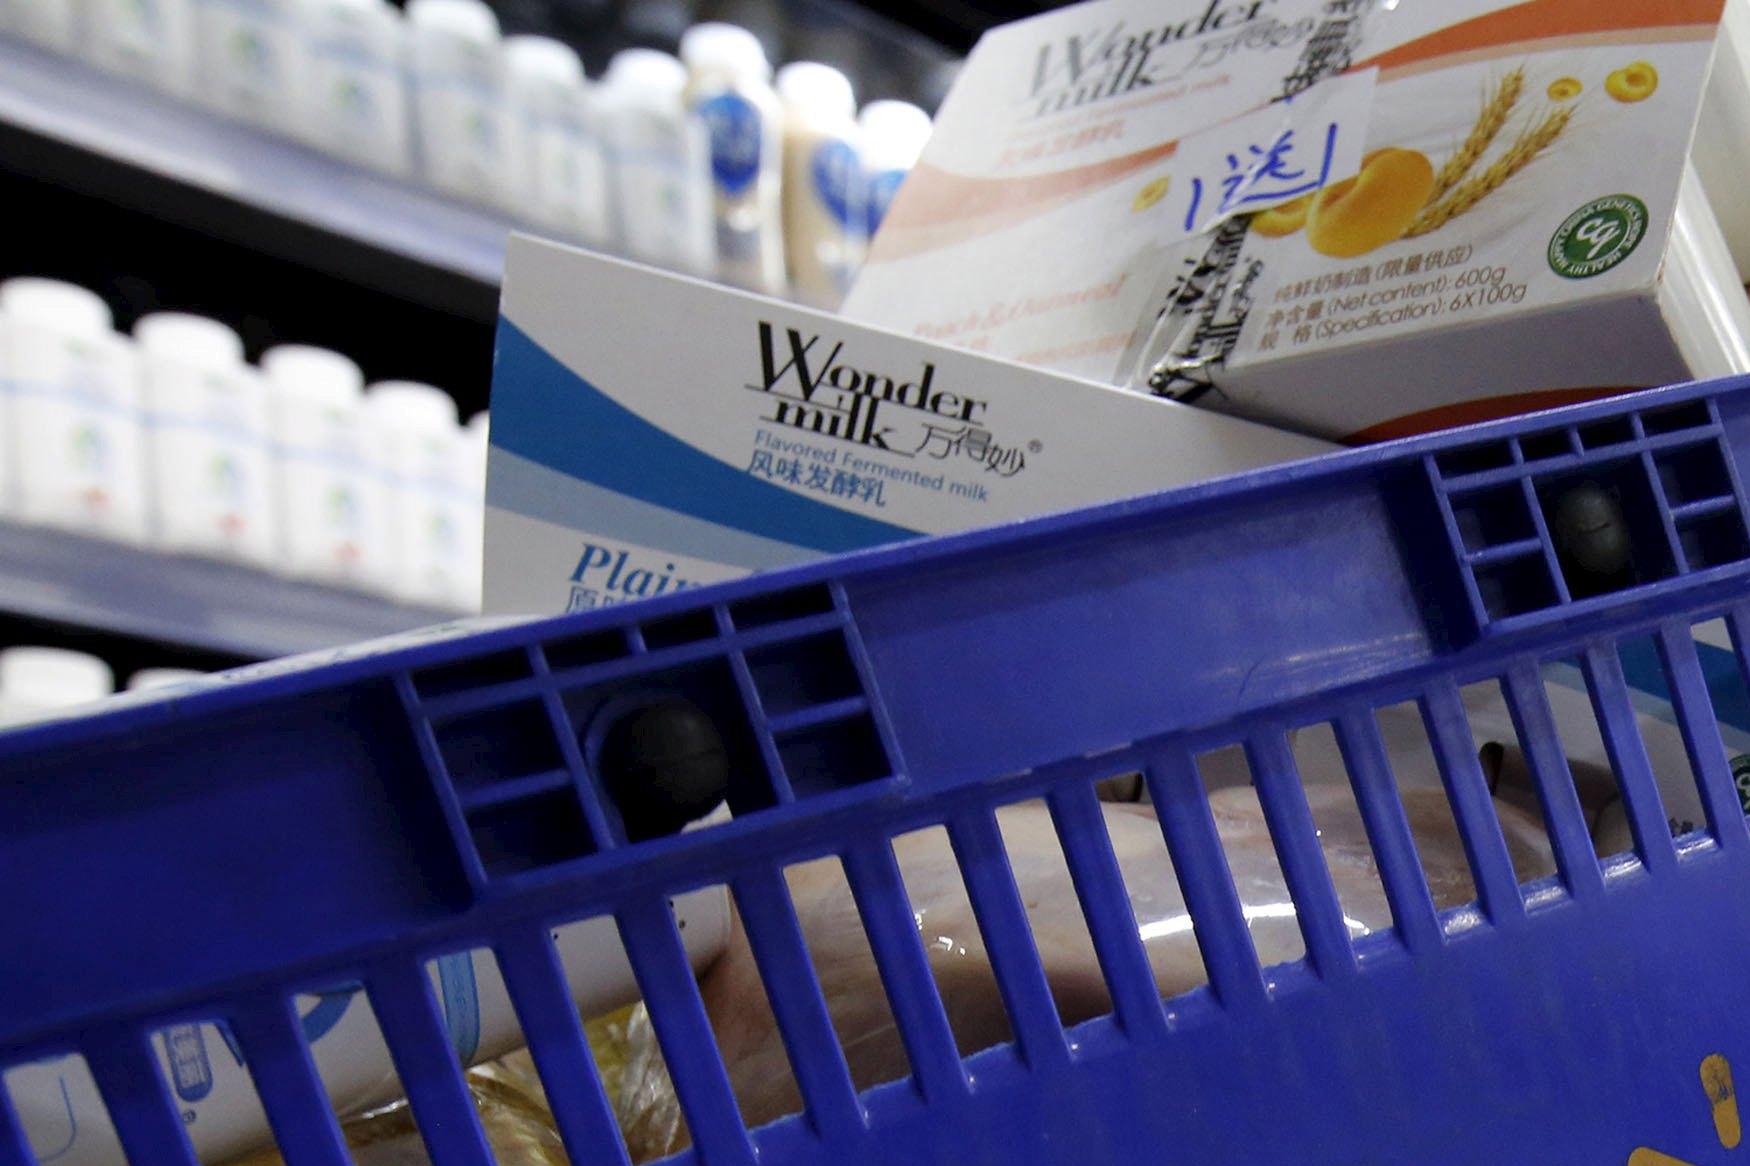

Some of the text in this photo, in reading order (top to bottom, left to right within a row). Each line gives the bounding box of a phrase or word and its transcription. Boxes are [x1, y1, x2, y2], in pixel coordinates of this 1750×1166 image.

[1455, 266, 1507, 294] 600g
[756, 320, 987, 426] Wonder
[760, 391, 915, 458] milk
[747, 449, 887, 507] 风味发酵乳
[755, 429, 989, 503] Flavored Fermented milk
[568, 542, 702, 598] Plai
